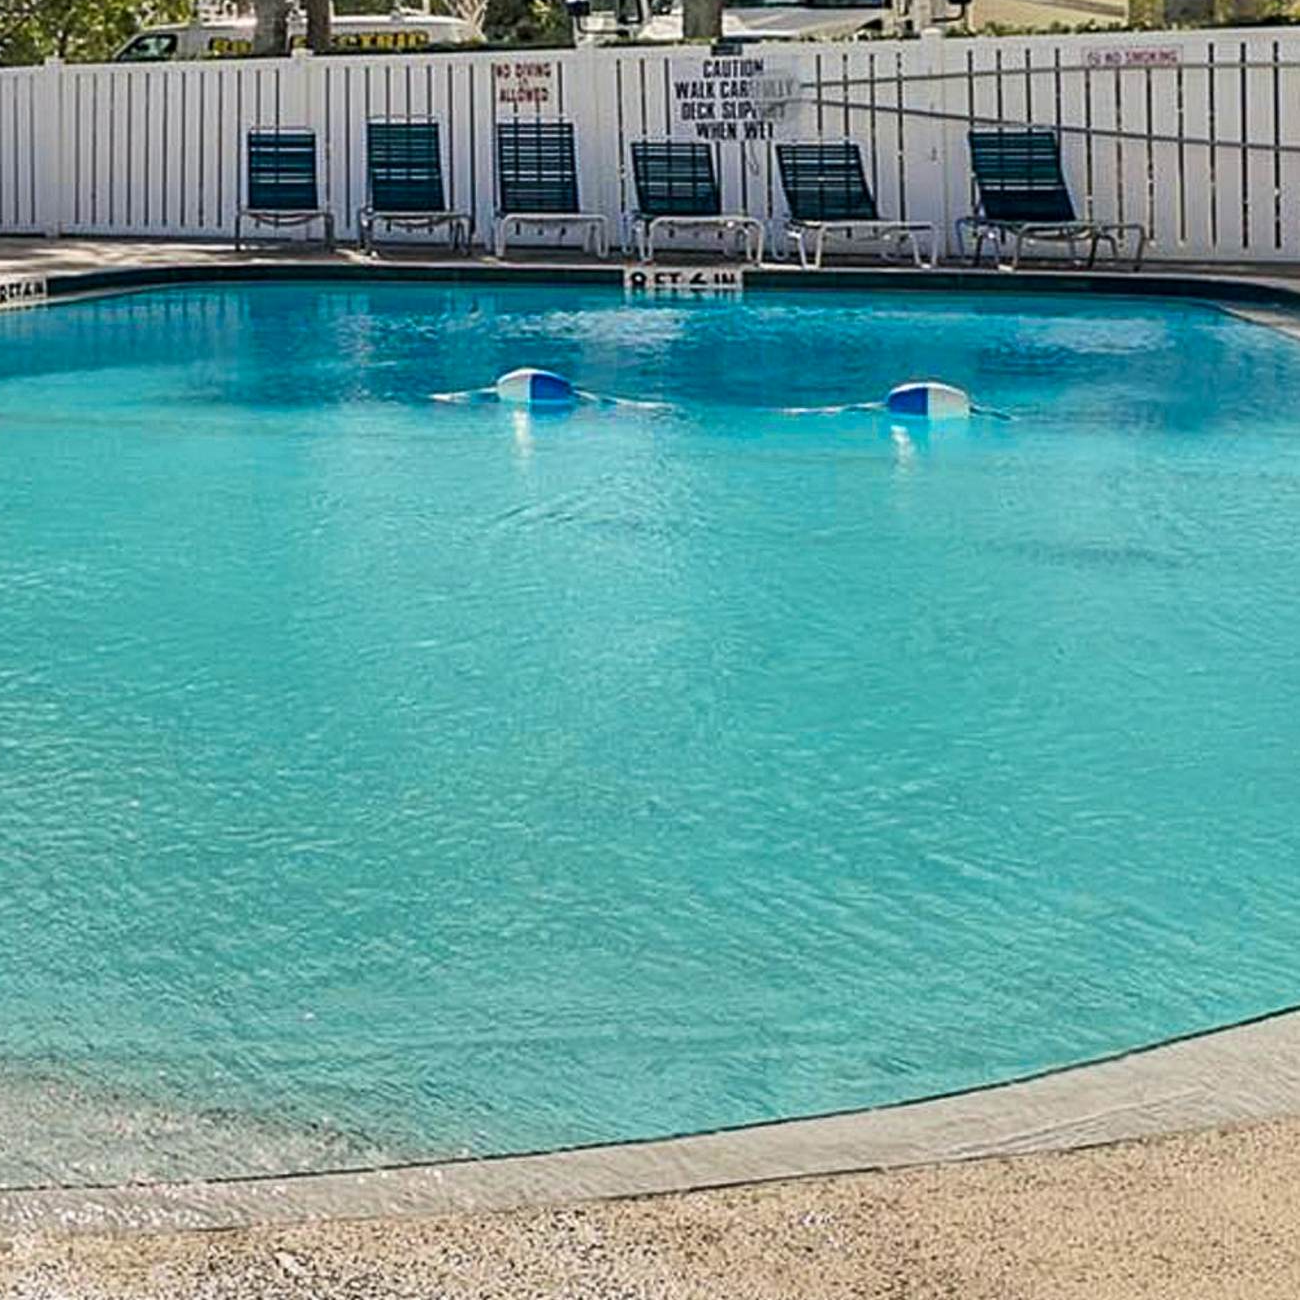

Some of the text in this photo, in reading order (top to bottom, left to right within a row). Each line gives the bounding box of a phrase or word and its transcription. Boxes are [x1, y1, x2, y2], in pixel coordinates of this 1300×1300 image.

[703, 59, 764, 79] CAUTION
[674, 81, 715, 99] WALK
[681, 102, 715, 120] DECK
[696, 122, 737, 140] WHEN
